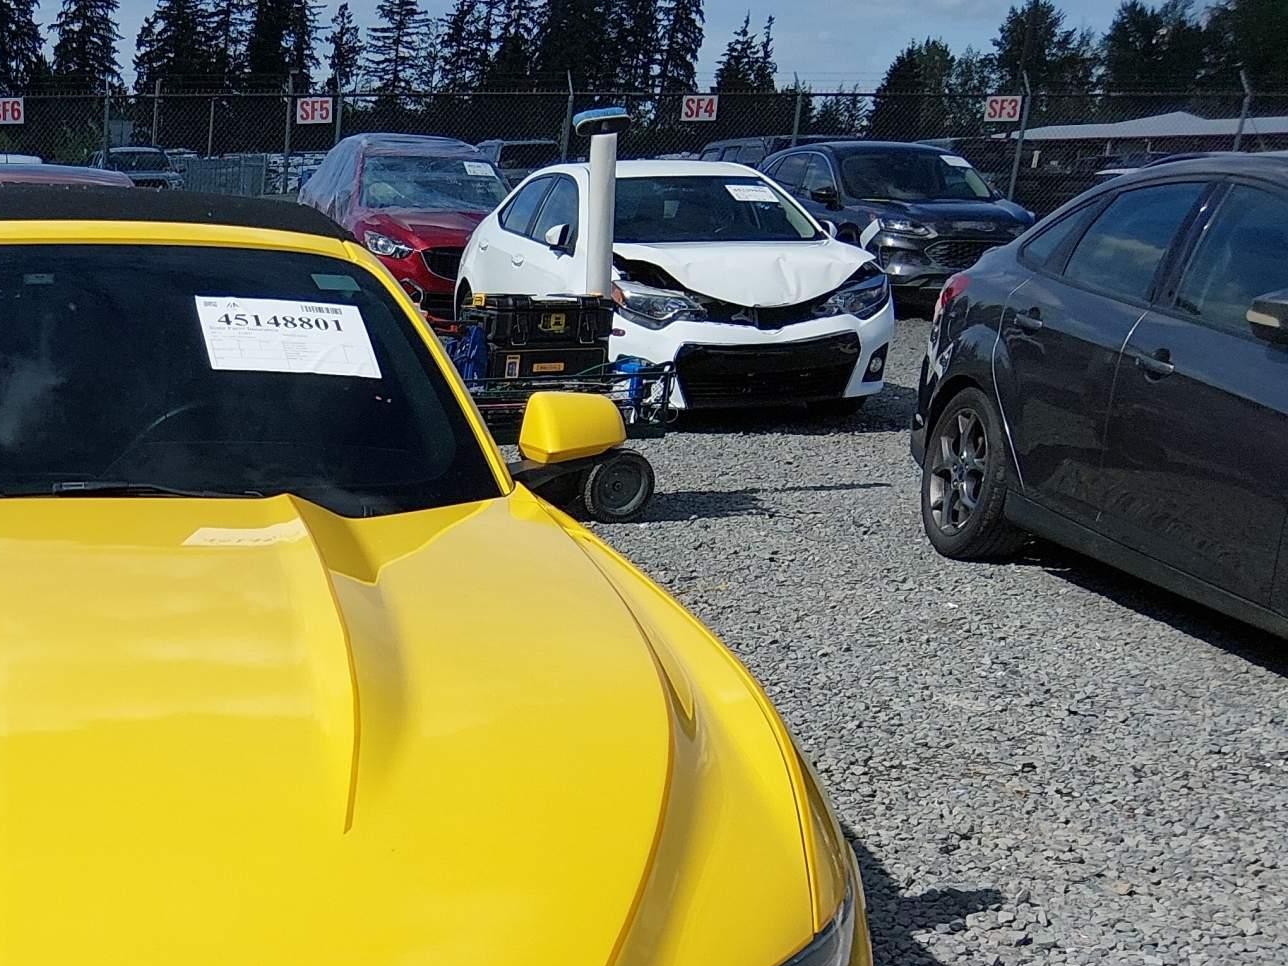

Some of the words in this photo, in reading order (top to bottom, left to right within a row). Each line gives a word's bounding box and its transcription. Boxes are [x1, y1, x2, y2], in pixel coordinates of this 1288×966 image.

[299, 100, 329, 120] SF5
[684, 98, 714, 118] SF4
[987, 99, 1018, 118] SF3
[217, 313, 344, 332] 45148801
